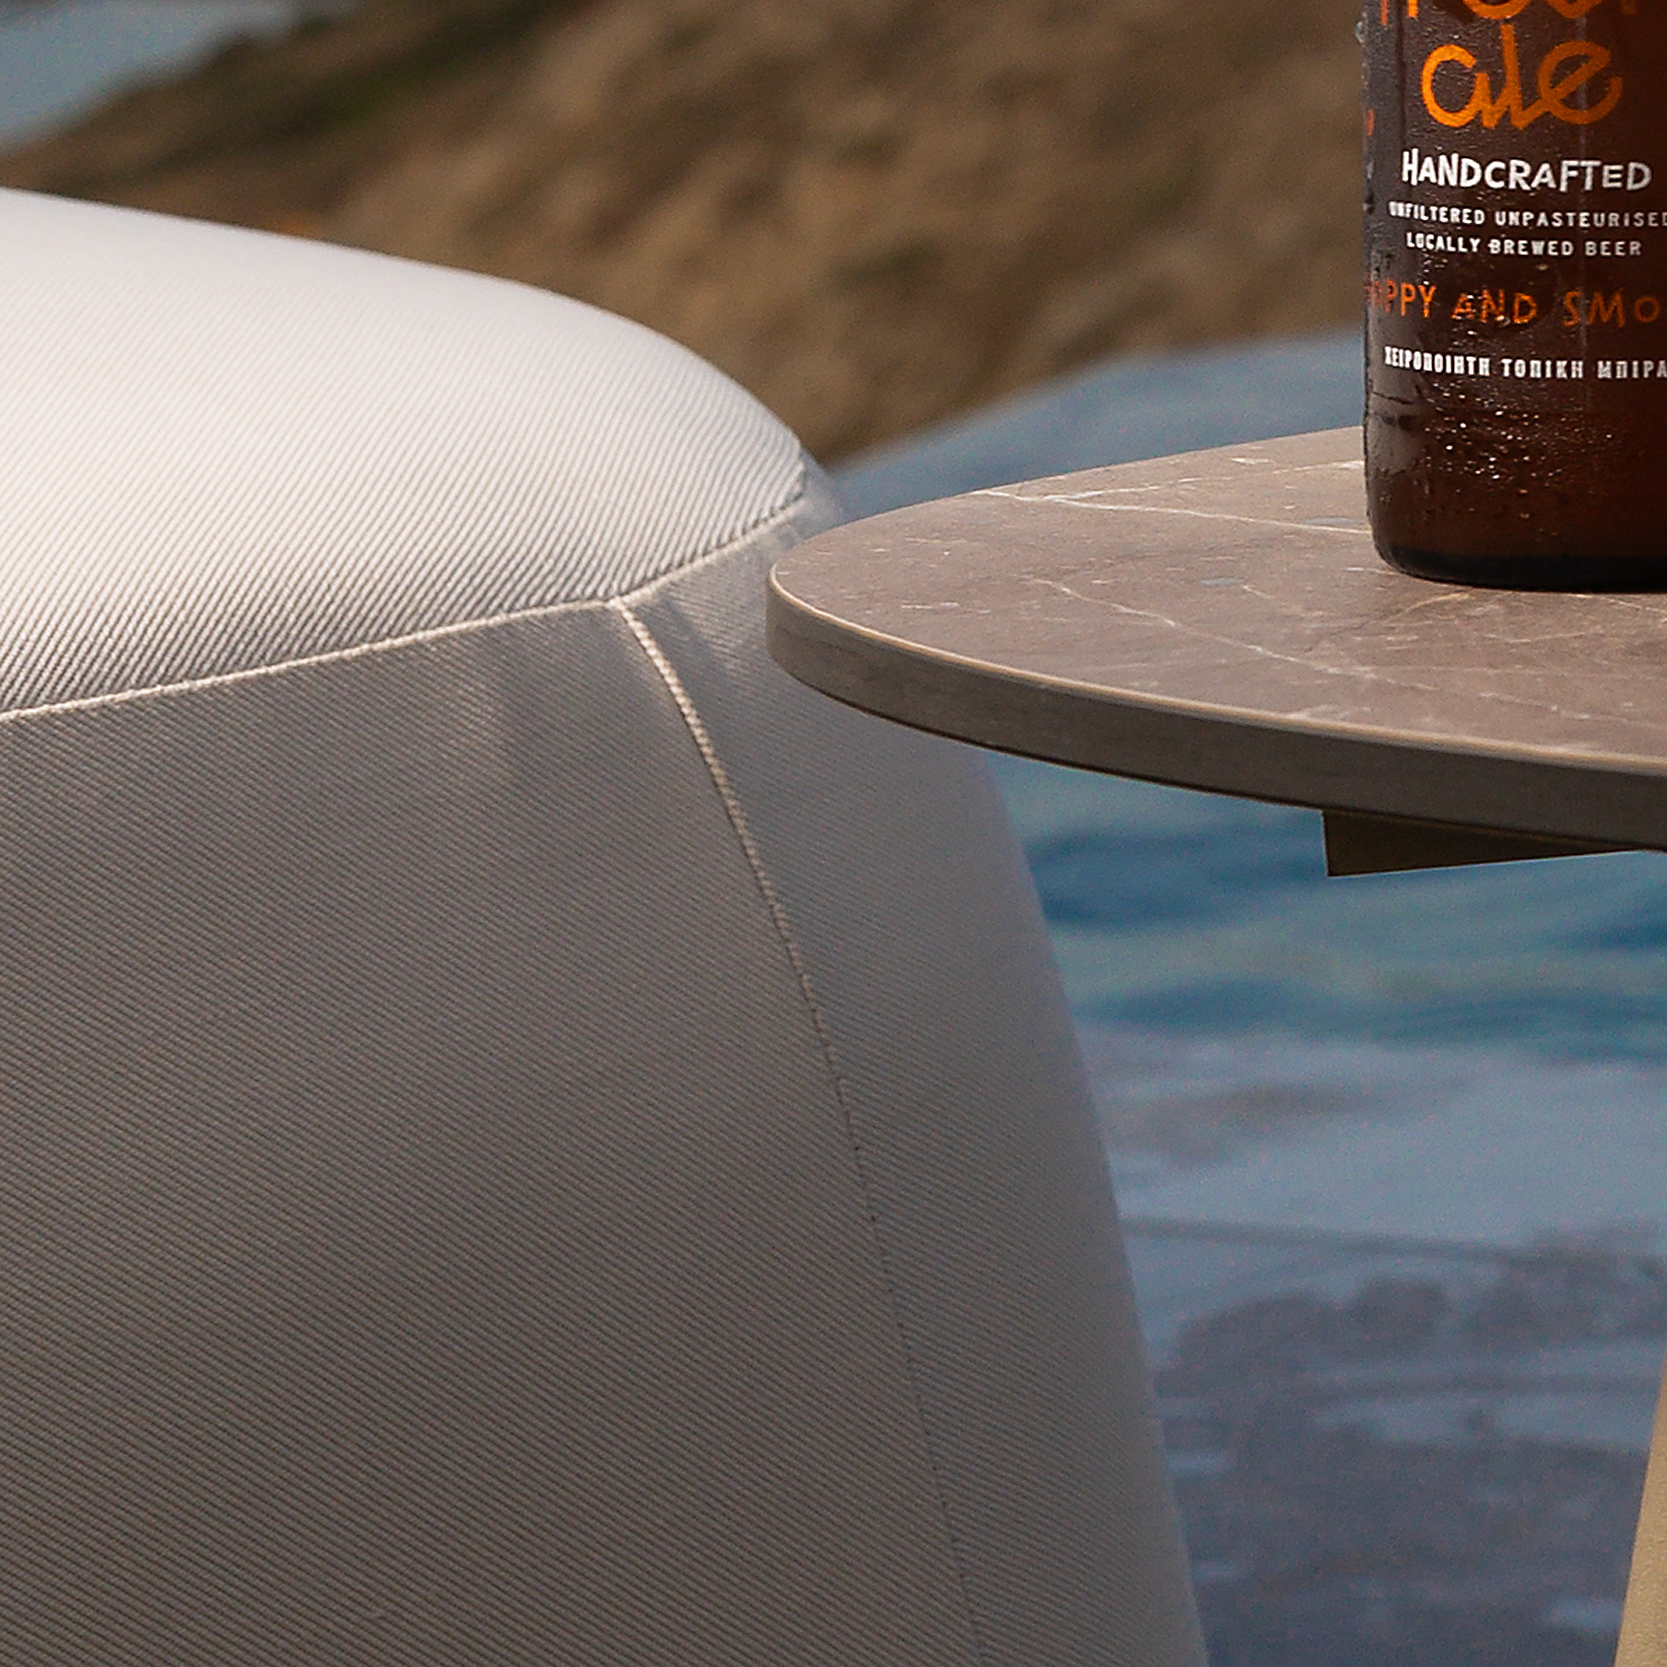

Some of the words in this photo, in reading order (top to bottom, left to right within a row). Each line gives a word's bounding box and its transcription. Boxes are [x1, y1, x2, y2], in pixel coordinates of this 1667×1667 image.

[1421, 24, 1624, 130] ale
[1401, 148, 1652, 192] HANDCRAFTED
[1388, 200, 1485, 226] UNFILTERED
[1406, 232, 1481, 254] LOCALLY
[1489, 239, 1575, 257] BREWED
[1585, 240, 1643, 257] BEER
[1451, 288, 1538, 324] AND
[1501, 357, 1585, 379] ΤΟΠΙΚΗ
